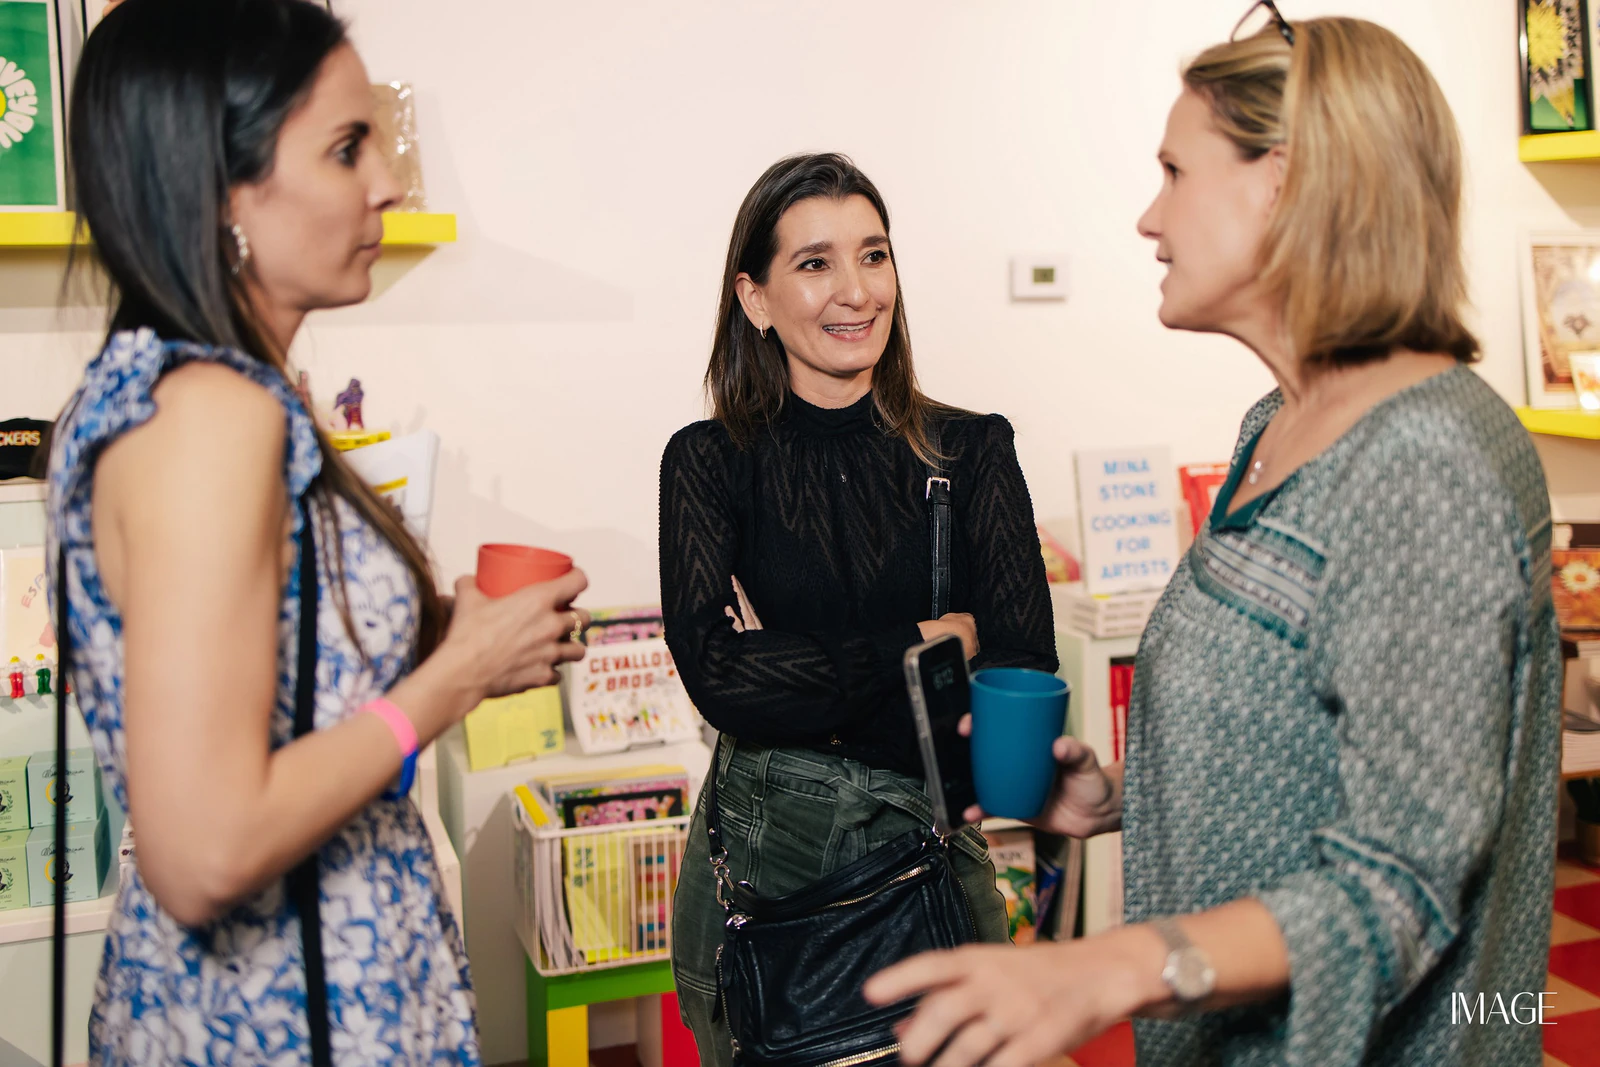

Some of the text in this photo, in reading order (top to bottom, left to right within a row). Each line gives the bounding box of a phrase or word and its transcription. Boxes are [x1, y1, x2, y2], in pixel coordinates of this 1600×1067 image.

[1103, 459, 1150, 475] MINA
[1099, 481, 1157, 502] STONE
[1091, 511, 1170, 532] COOKING
[1116, 535, 1150, 553] FOR
[1101, 558, 1170, 579] ARTISTS
[606, 672, 653, 692] BROS
